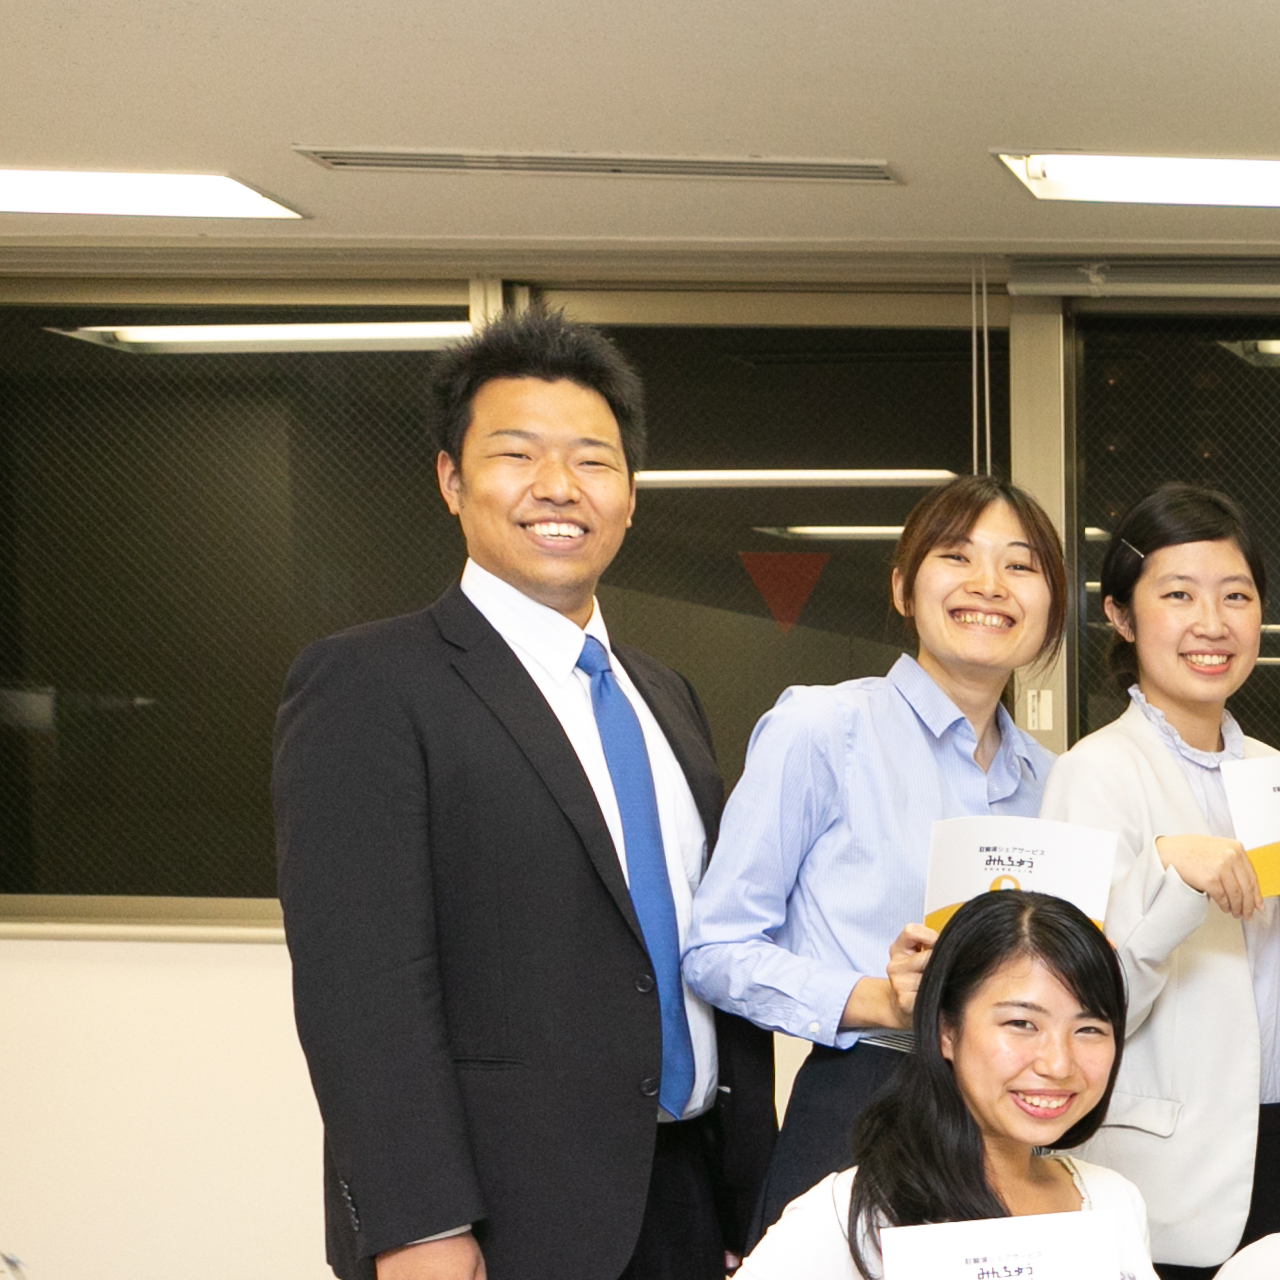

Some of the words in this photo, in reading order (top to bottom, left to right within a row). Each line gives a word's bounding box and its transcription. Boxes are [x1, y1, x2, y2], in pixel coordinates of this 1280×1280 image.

[977, 1263, 1033, 1280] みんちゅう
